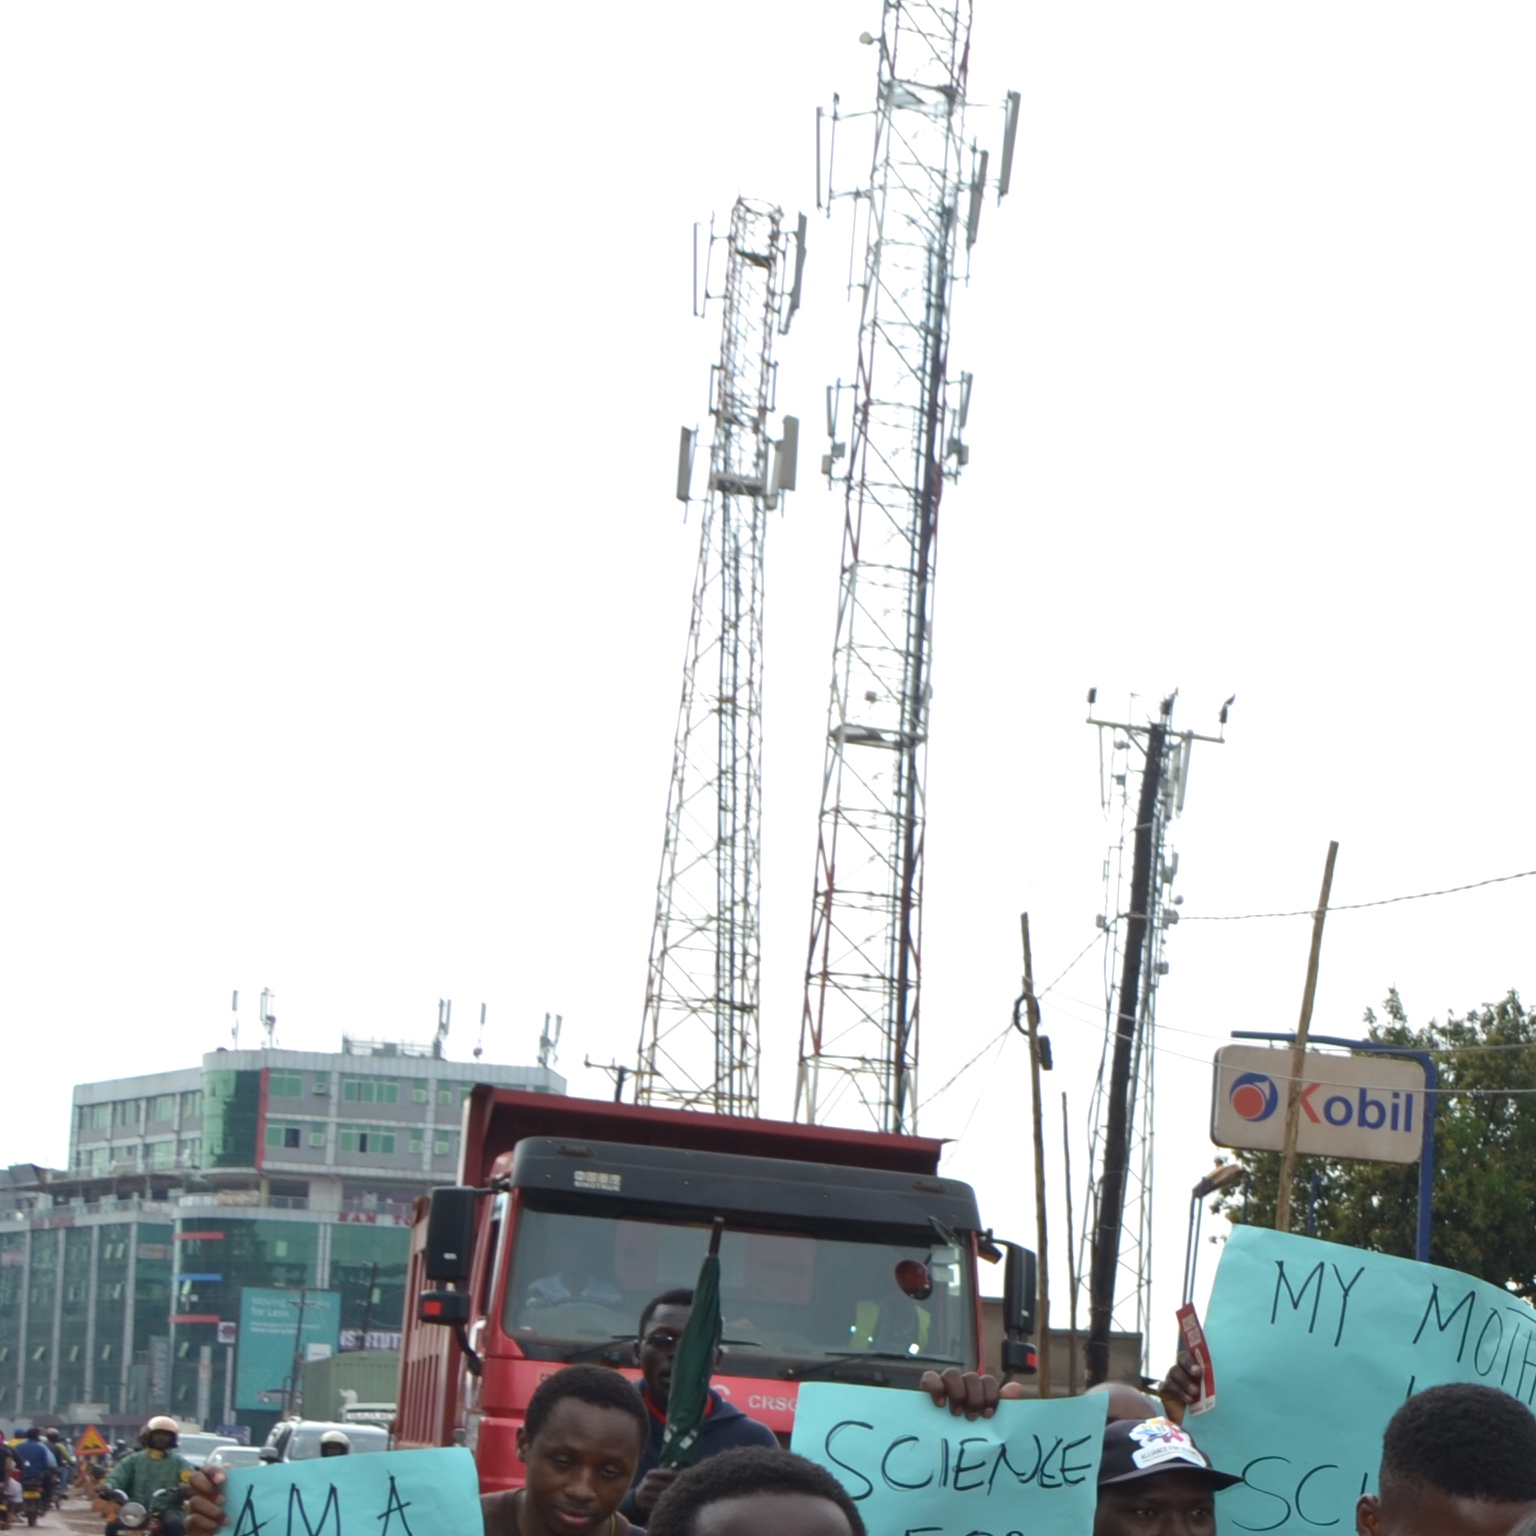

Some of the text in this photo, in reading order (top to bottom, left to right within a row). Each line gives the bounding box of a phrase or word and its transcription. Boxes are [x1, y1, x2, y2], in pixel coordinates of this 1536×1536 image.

[1299, 1082, 1413, 1133] Kobil
[1269, 1260, 1366, 1347] MY
[825, 1418, 1095, 1501] SCIENCE
